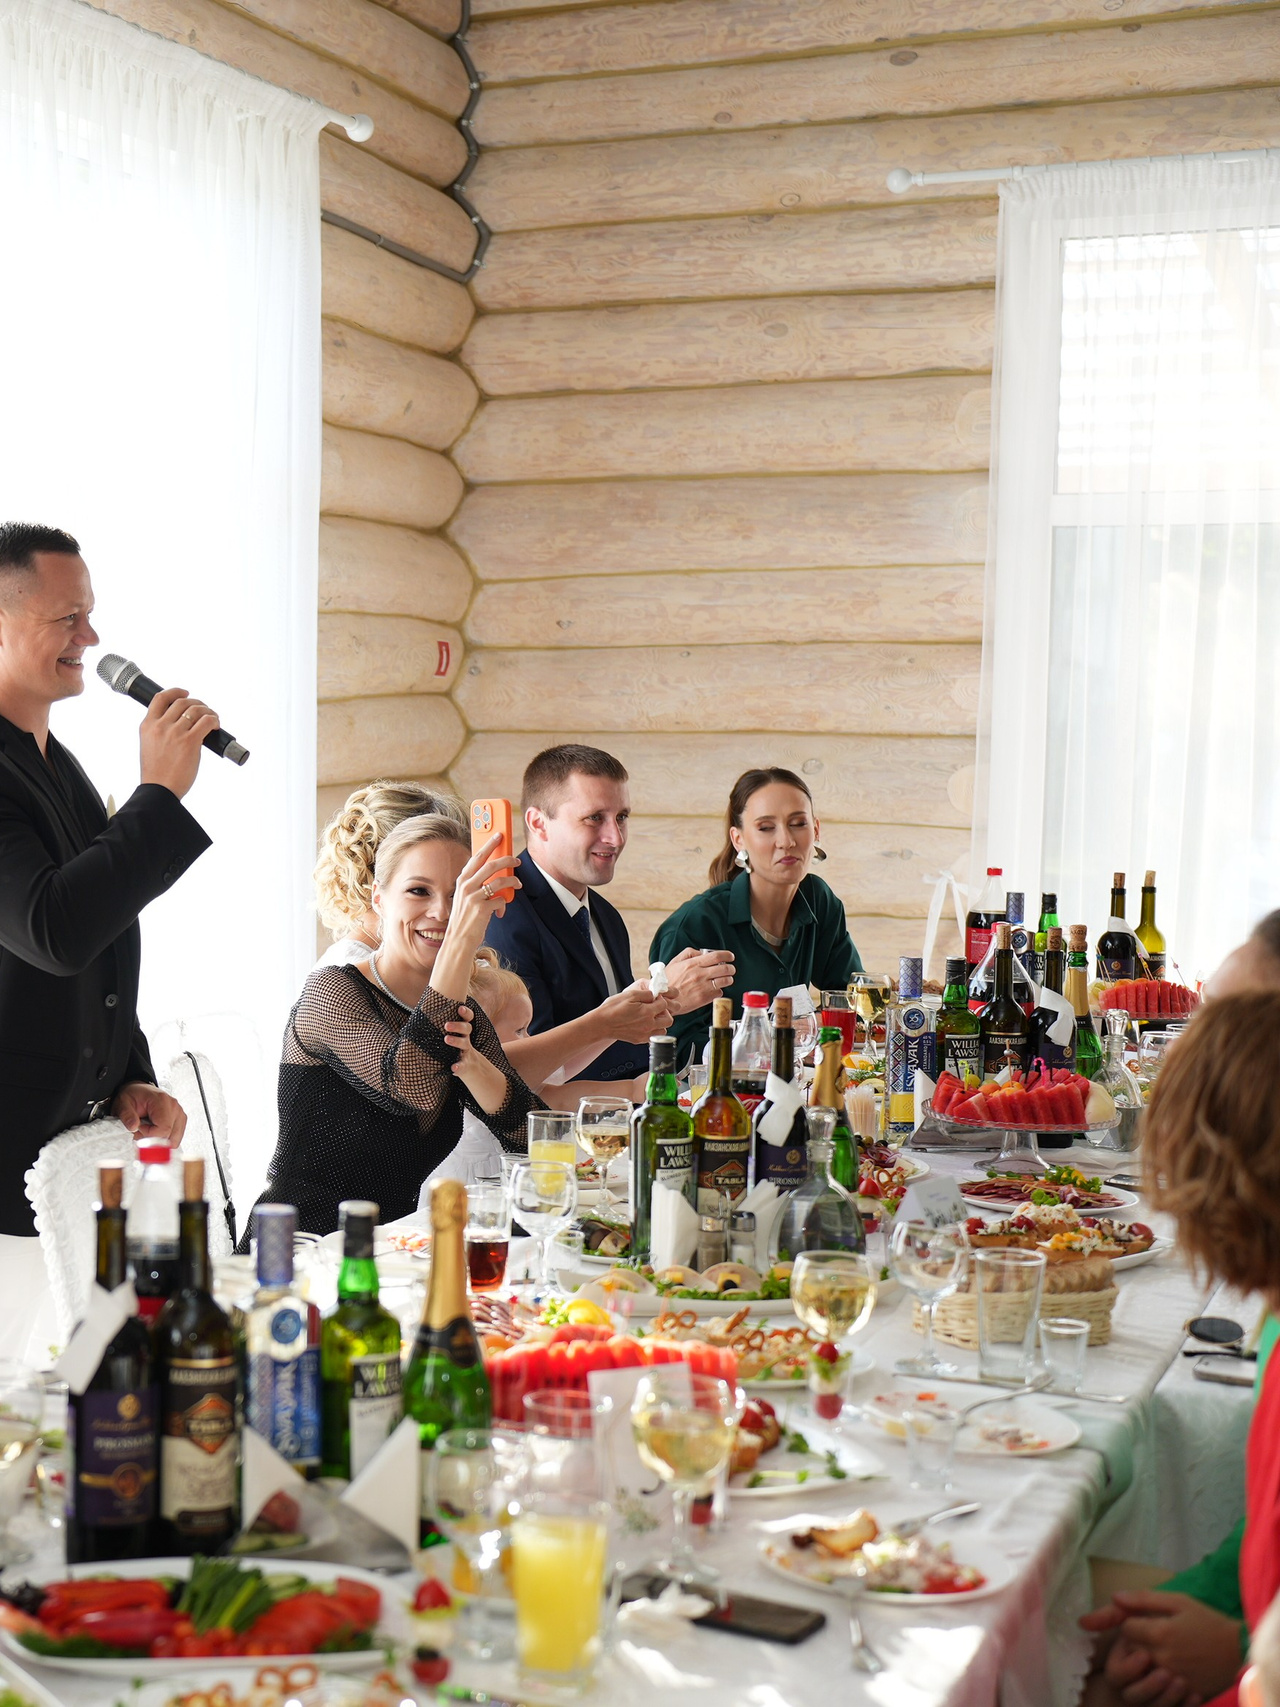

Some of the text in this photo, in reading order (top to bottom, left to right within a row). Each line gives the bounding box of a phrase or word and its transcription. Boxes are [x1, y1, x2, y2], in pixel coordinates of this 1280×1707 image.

[951, 1040, 980, 1049] WILLIA
[948, 1048, 980, 1057] LAWSO
[906, 1038, 919, 1087] SVAYAK
[663, 1143, 693, 1157] WILLI
[660, 1156, 692, 1169] LAWS
[768, 1176, 803, 1186] PIROSM
